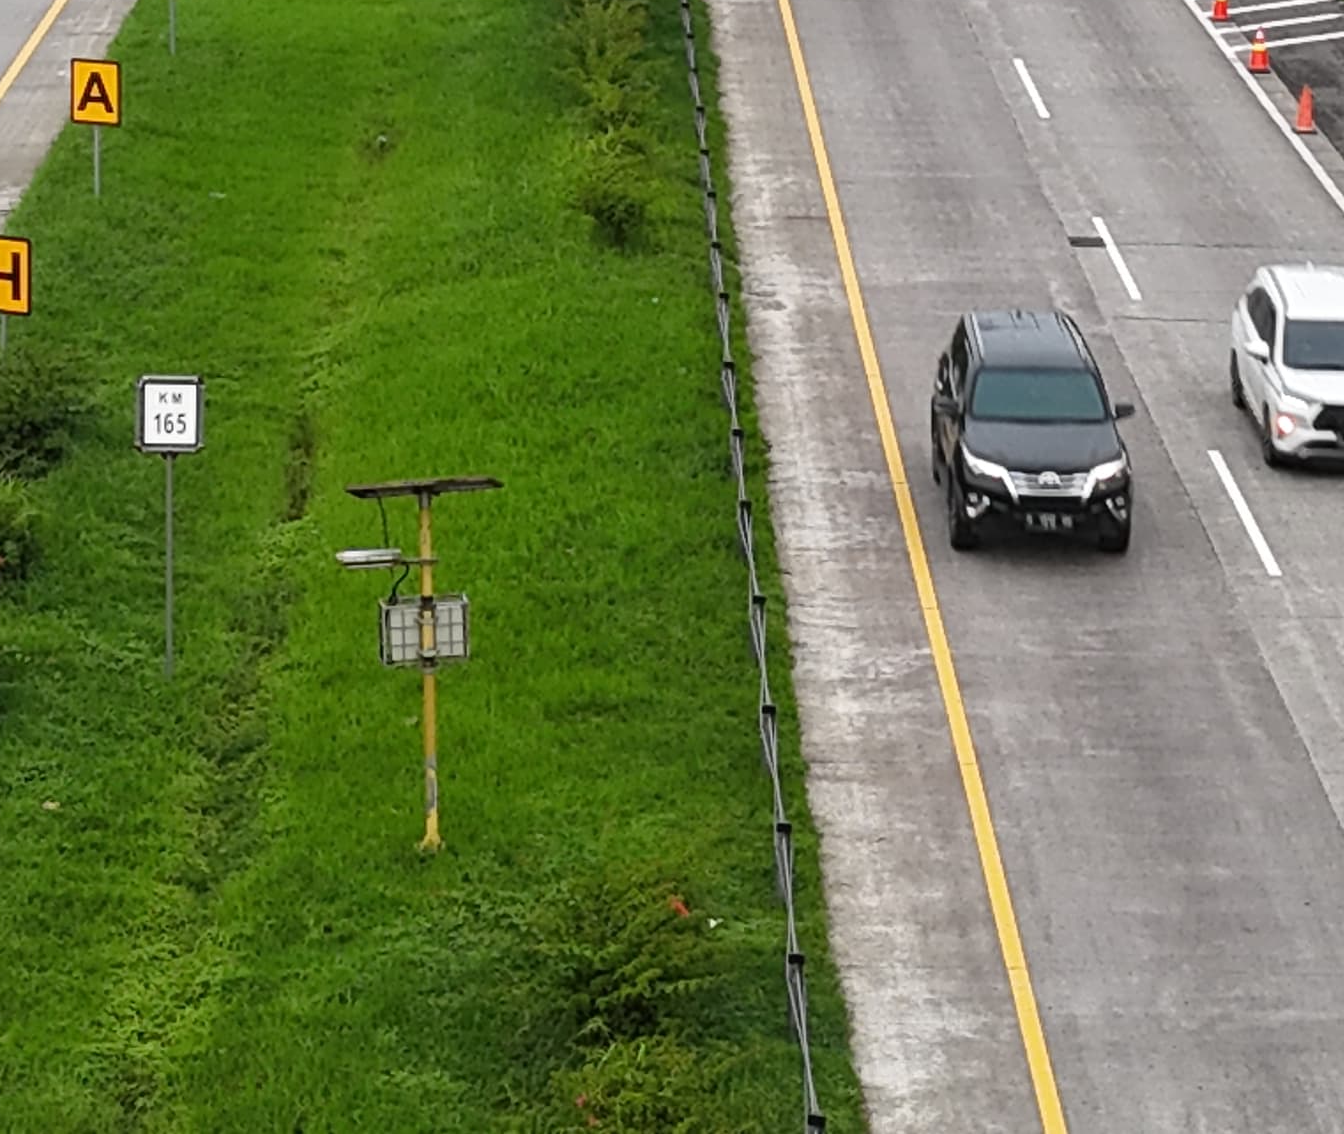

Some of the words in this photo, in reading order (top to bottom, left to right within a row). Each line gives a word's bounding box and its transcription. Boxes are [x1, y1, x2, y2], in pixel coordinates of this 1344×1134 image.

[76, 72, 114, 113] A
[158, 392, 182, 403] KM
[154, 413, 186, 434] 165
